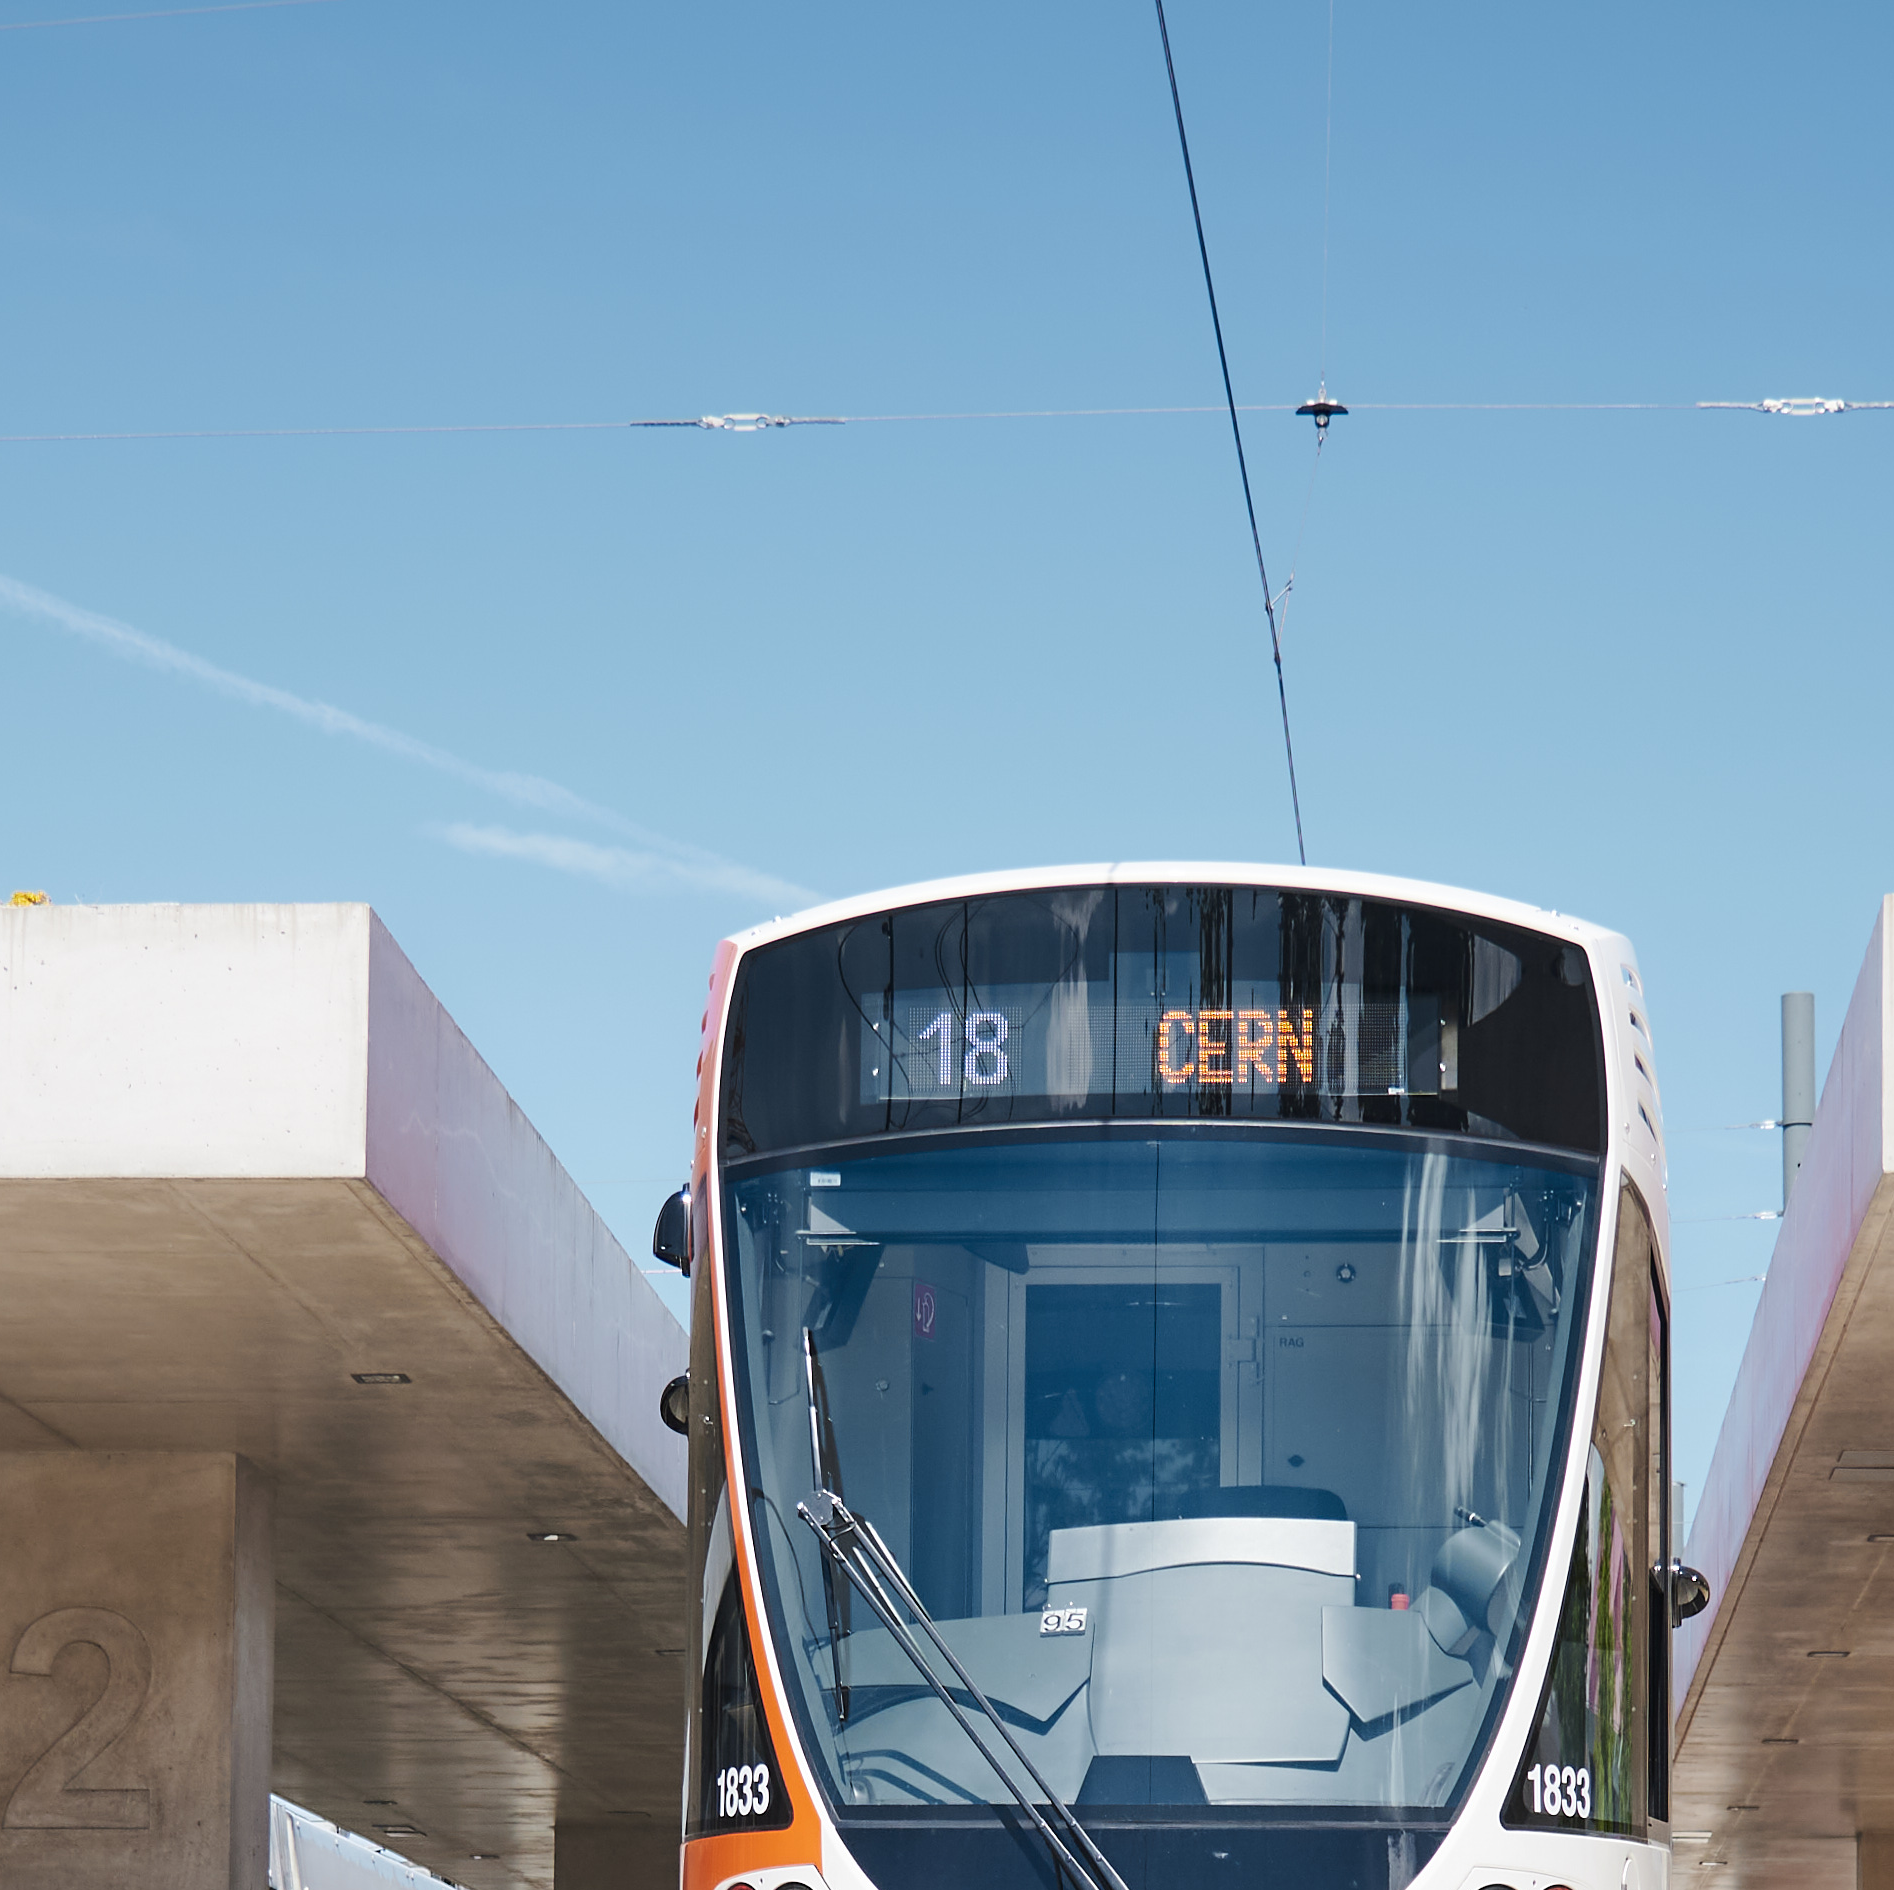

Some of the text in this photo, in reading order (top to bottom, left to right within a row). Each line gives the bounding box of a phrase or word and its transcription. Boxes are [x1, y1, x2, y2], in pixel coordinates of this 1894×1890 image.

[919, 1009, 1313, 1085] 18 CERN
[1044, 1612, 1084, 1631] 95
[1, 1605, 152, 1830] 2
[717, 1763, 770, 1818] 1833
[1527, 1763, 1591, 1819] 1833
